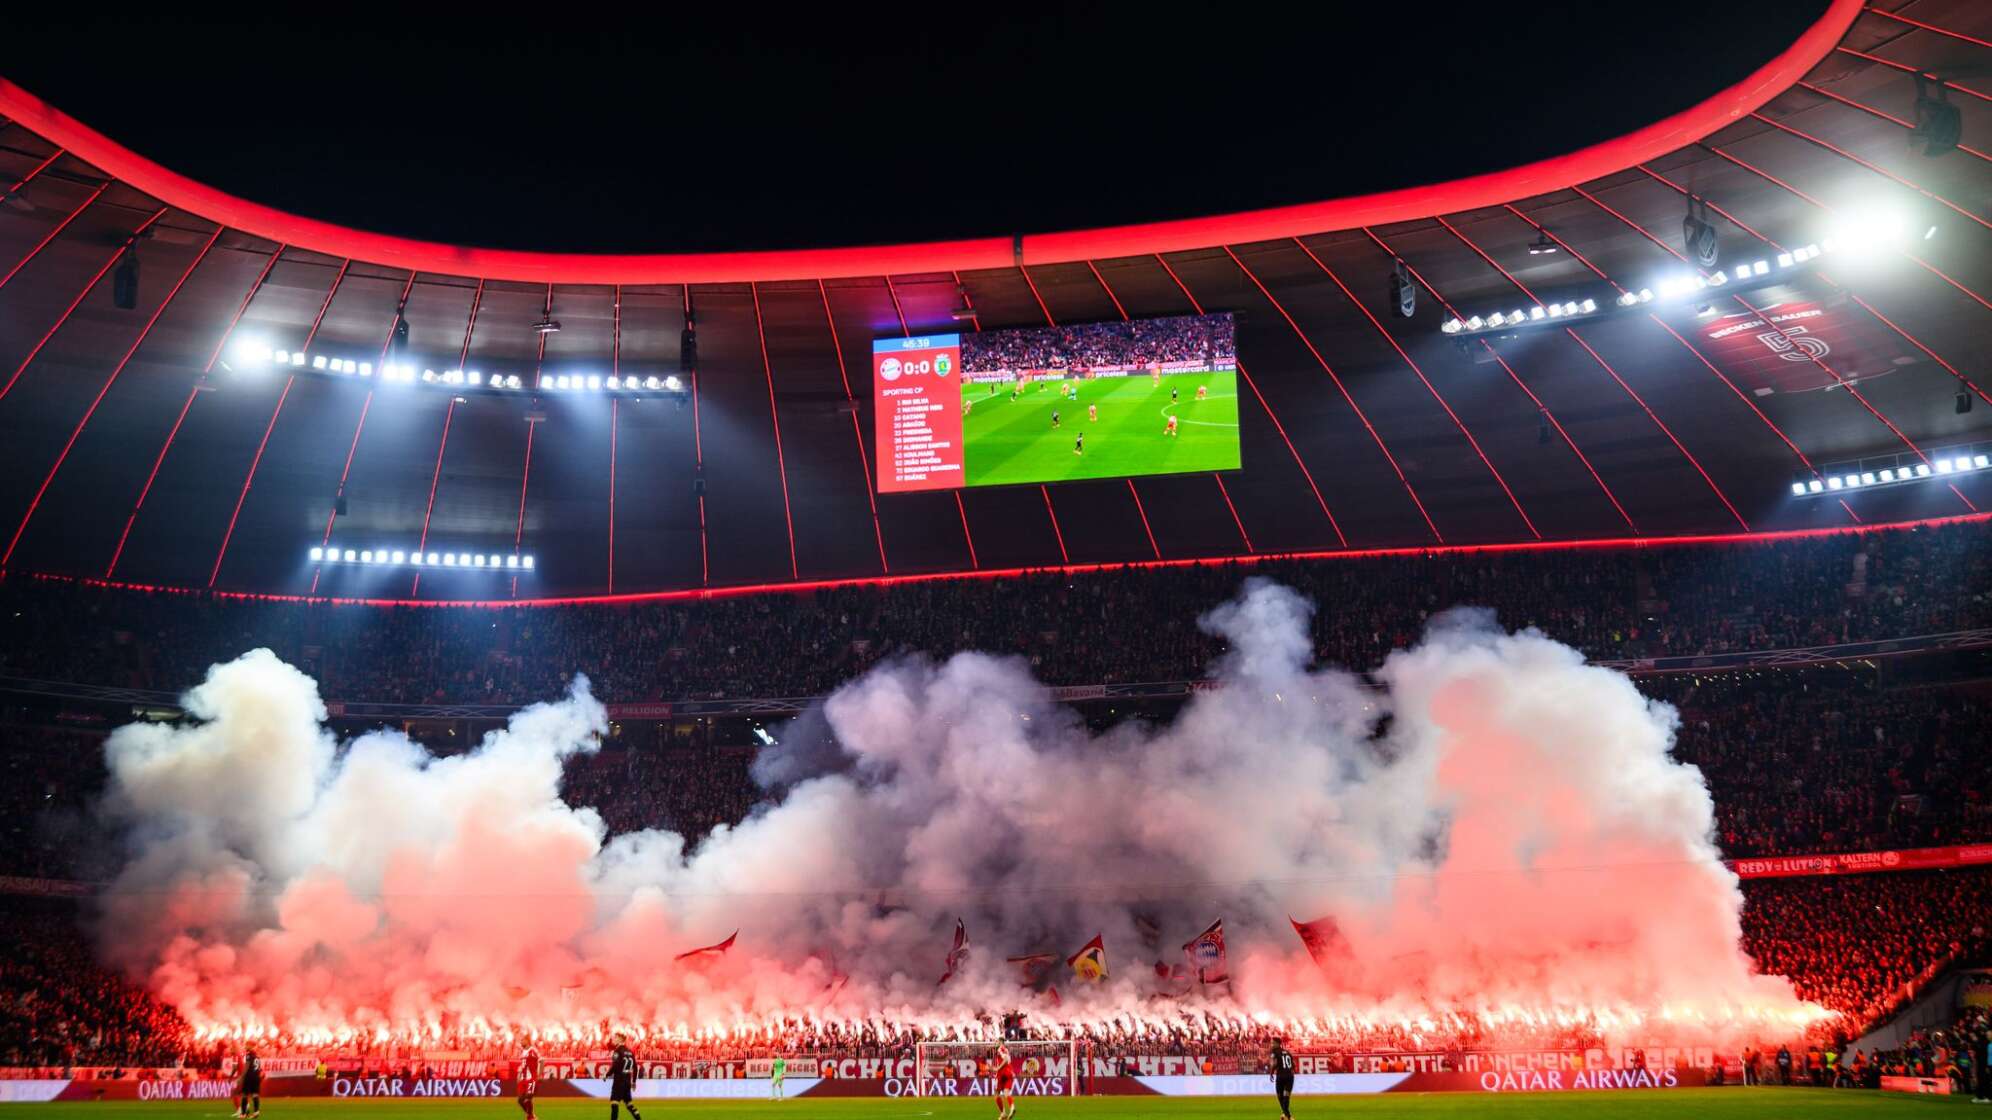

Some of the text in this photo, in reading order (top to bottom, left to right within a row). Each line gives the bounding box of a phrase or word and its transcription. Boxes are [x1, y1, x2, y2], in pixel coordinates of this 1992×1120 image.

[1709, 309, 1822, 339] BECKEN BAUER
[1756, 326, 1830, 361] 5
[1161, 365, 1209, 375] mastercard
[882, 387, 913, 396] SPORTING
[263, 1061, 316, 1072] BRETTEN
[1282, 1055, 1292, 1068] 10
[137, 1080, 183, 1099] QATAR
[333, 1078, 502, 1098] QATAR AIRWAYS
[667, 1080, 770, 1097] priceless
[884, 1078, 958, 1098] QATAR
[1223, 1077, 1336, 1096] pricess
[1481, 1068, 1677, 1092] QATAR AIRWAYS
